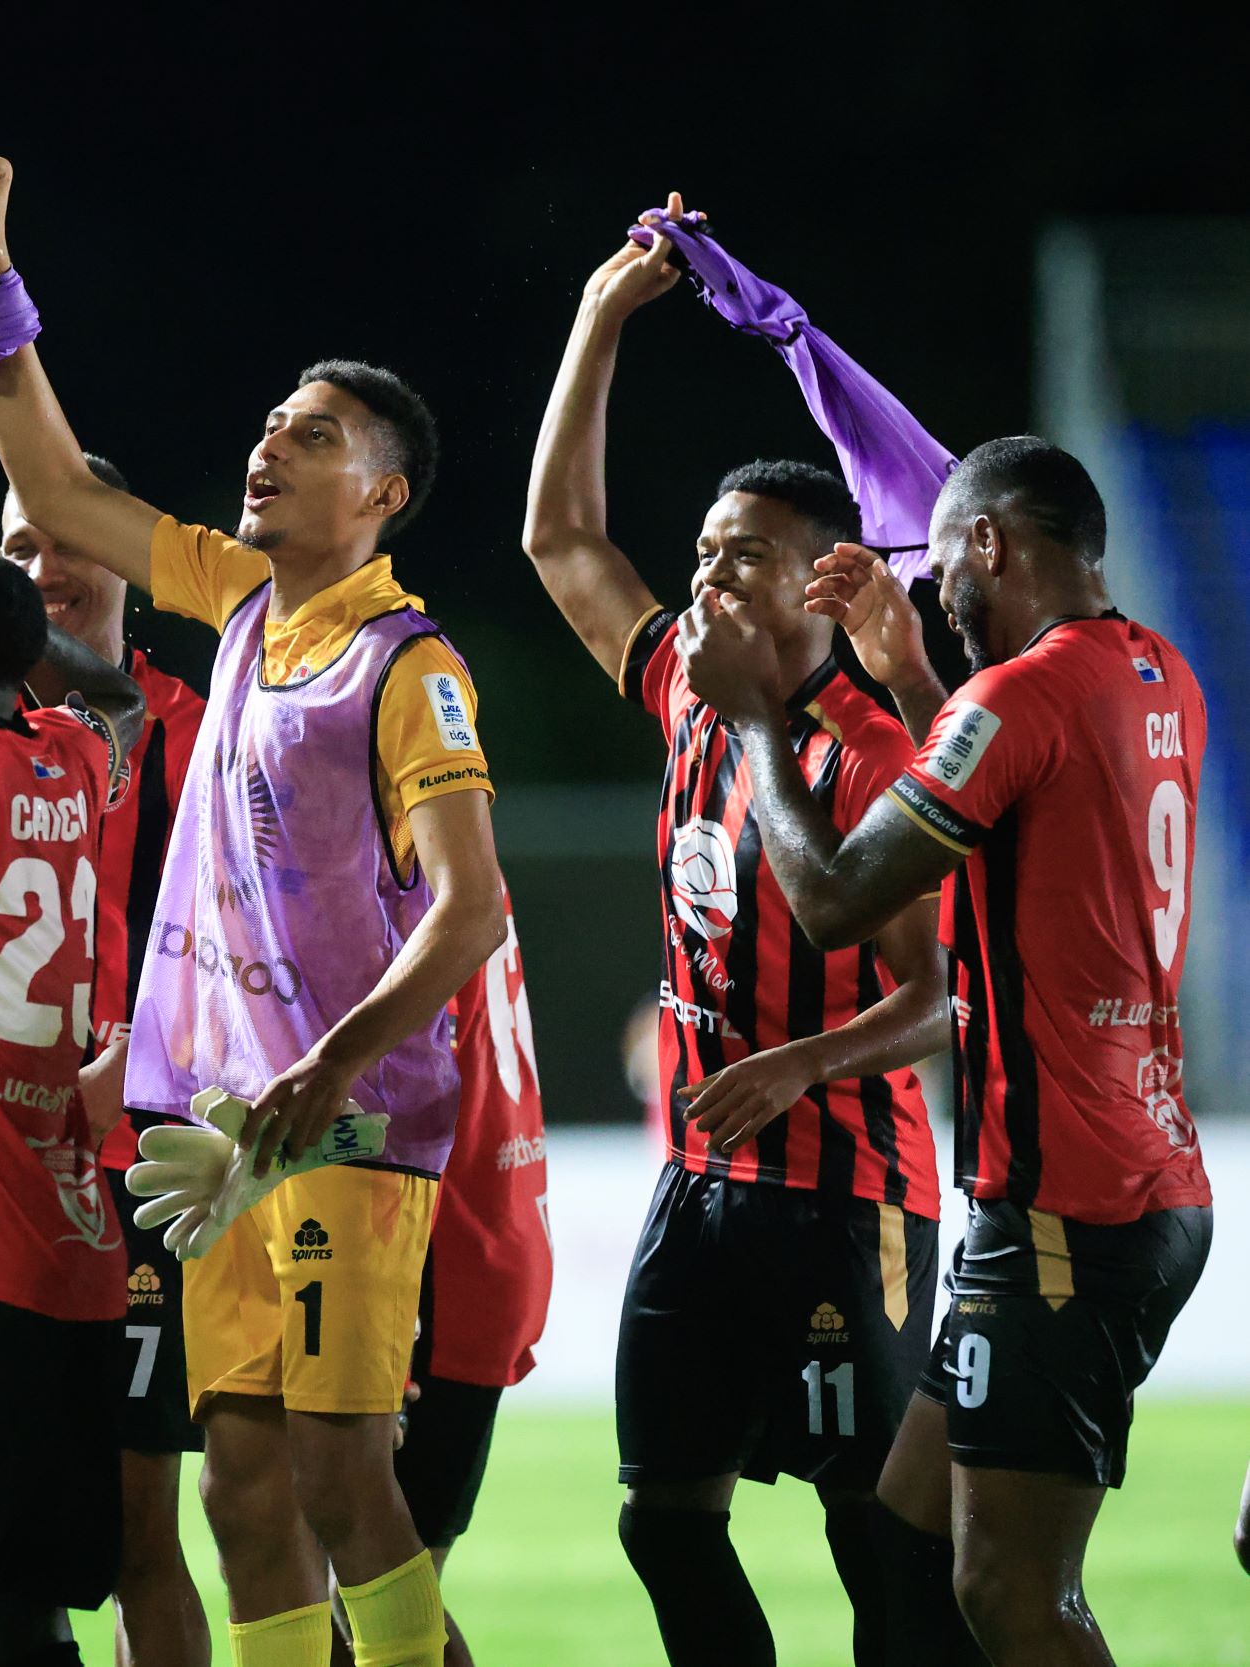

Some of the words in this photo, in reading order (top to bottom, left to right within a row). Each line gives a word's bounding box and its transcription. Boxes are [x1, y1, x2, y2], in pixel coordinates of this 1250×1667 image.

[937, 755, 962, 779] tigo
[1148, 780, 1186, 972] 9
[291, 1248, 333, 1262] spirits
[295, 1281, 323, 1357] 1
[806, 1330, 849, 1344] spirits
[125, 1325, 161, 1397] 7
[956, 1333, 991, 1408] 9
[801, 1360, 855, 1436] 11
